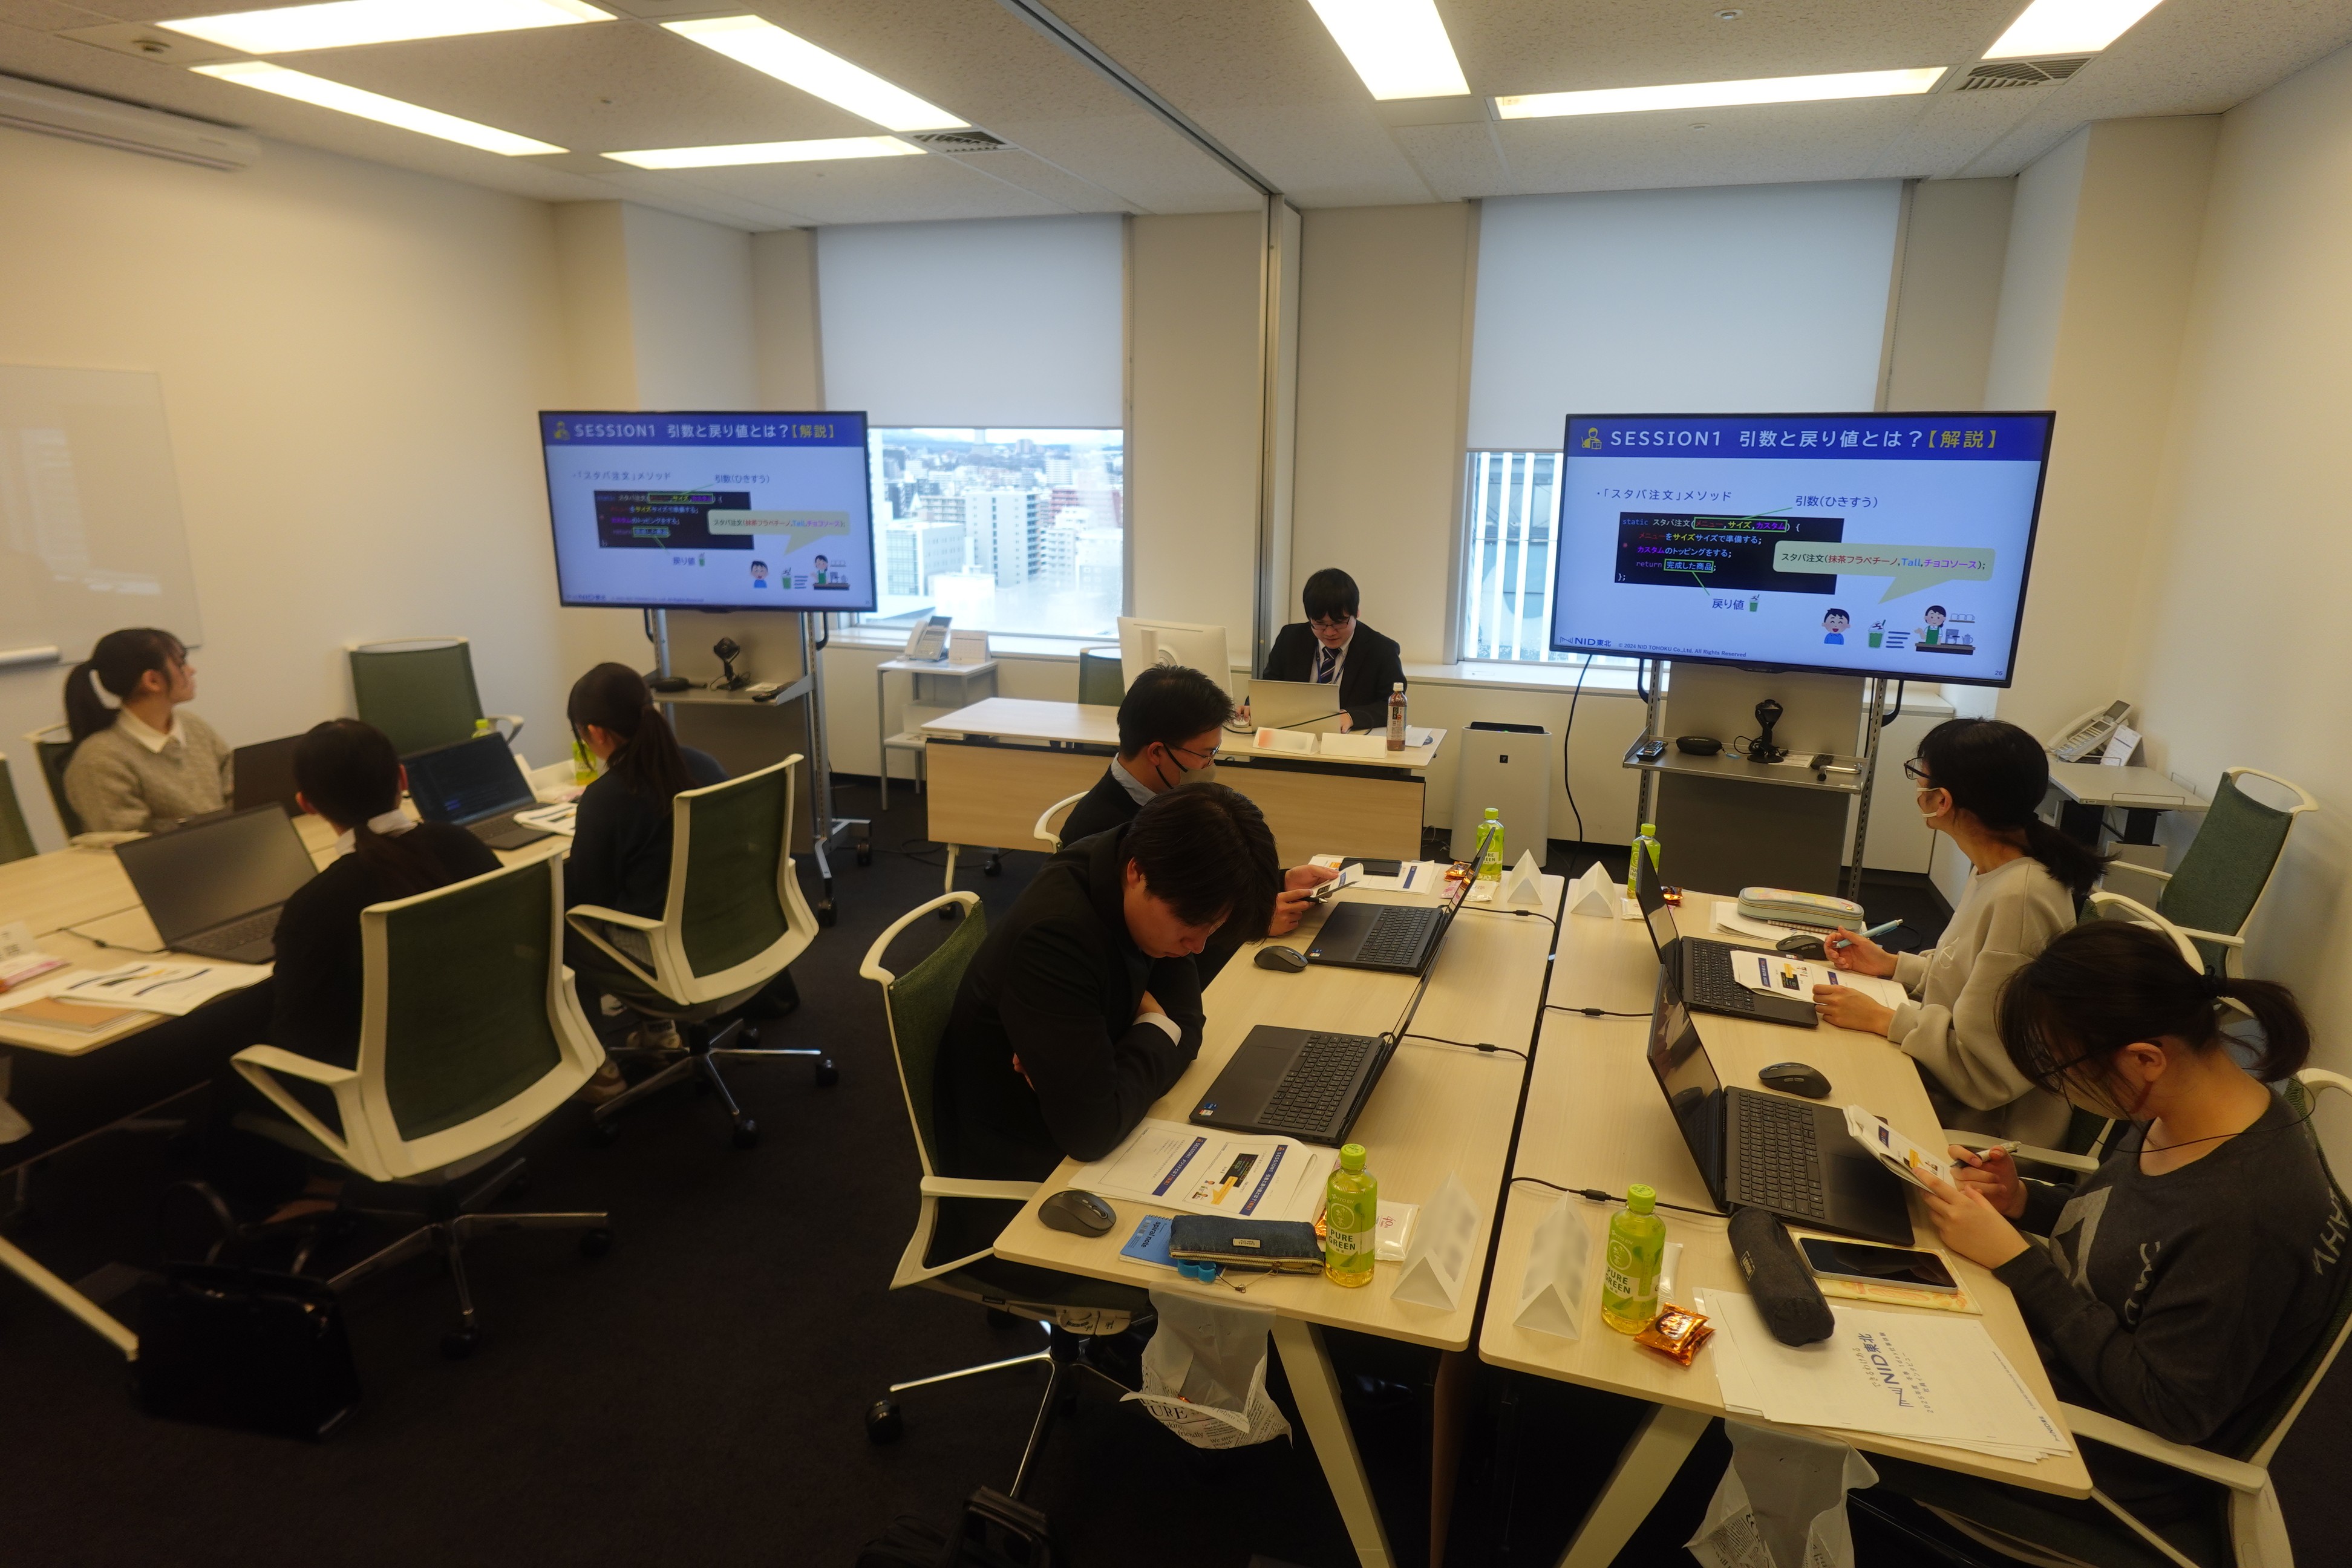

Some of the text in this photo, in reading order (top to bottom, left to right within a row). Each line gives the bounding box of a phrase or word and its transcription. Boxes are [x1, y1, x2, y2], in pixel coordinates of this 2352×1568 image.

[574, 424, 655, 437] SESSION1
[1610, 431, 1720, 446] SESSION1
[1622, 518, 1648, 526] static
[1712, 598, 1744, 610] 戻り値
[1141, 1221, 1161, 1248] spiral note
[1331, 1229, 1353, 1242] PURE
[1329, 1236, 1356, 1250] GREEN
[1607, 1266, 1628, 1285] PURE
[1605, 1274, 1631, 1294] GREEN
[1858, 1333, 1900, 1385] NID東北
